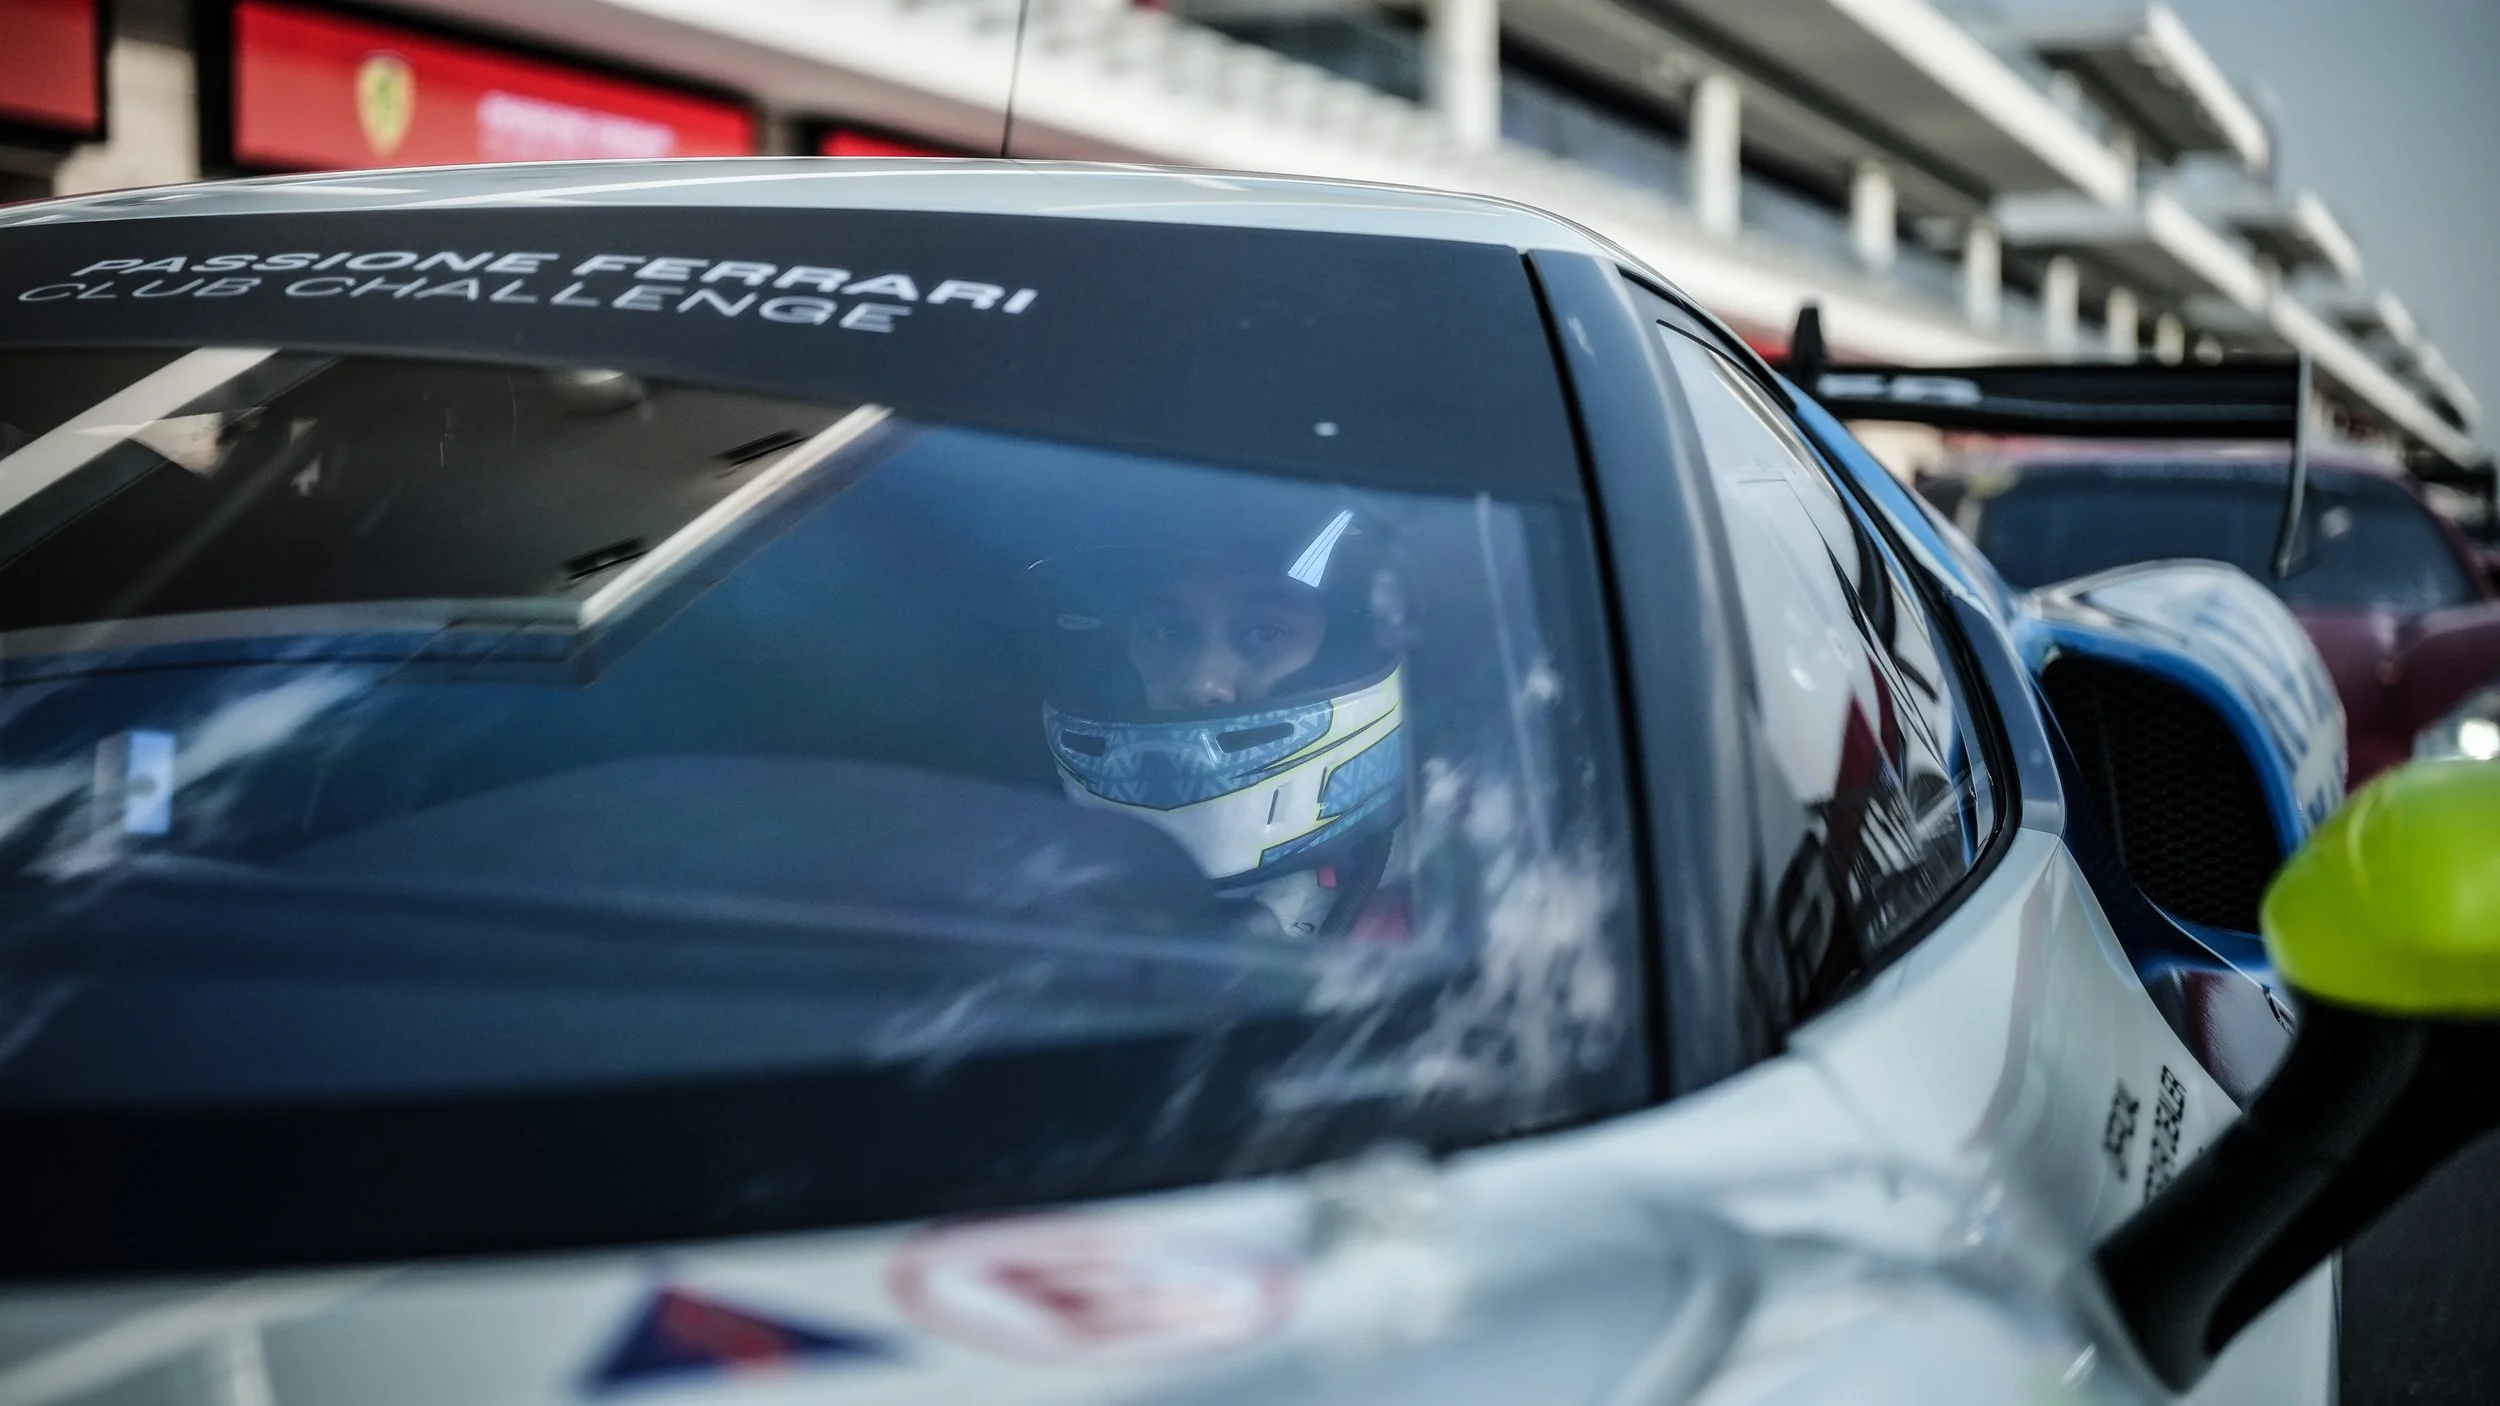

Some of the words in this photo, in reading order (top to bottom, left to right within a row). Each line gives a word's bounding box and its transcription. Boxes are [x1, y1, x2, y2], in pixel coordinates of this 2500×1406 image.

[18, 278, 262, 301] CLUB
[286, 277, 912, 333] CHALLENGE
[70, 251, 560, 276] PASSIONE
[571, 254, 1037, 314] FERRARI
